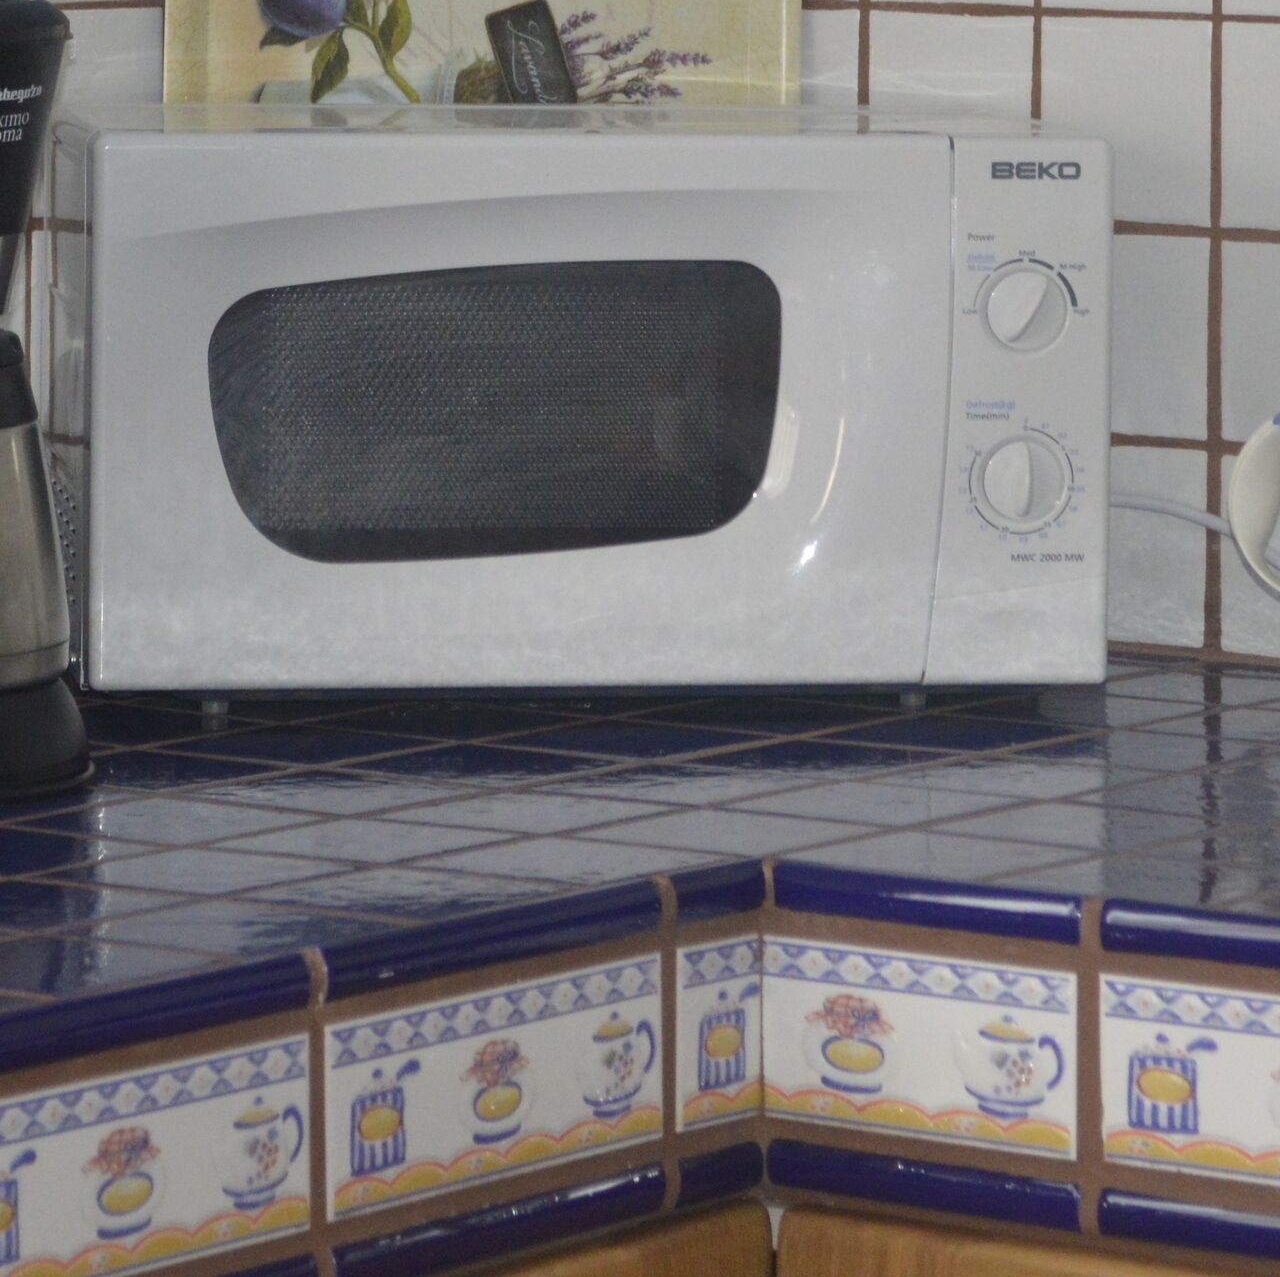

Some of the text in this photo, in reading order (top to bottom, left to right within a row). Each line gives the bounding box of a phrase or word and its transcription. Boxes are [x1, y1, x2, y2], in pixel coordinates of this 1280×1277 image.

[990, 161, 1082, 181] BEKO
[967, 232, 995, 242] Power
[965, 412, 1010, 421] Time(min)
[1010, 553, 1085, 562] MWC 2000 MW
